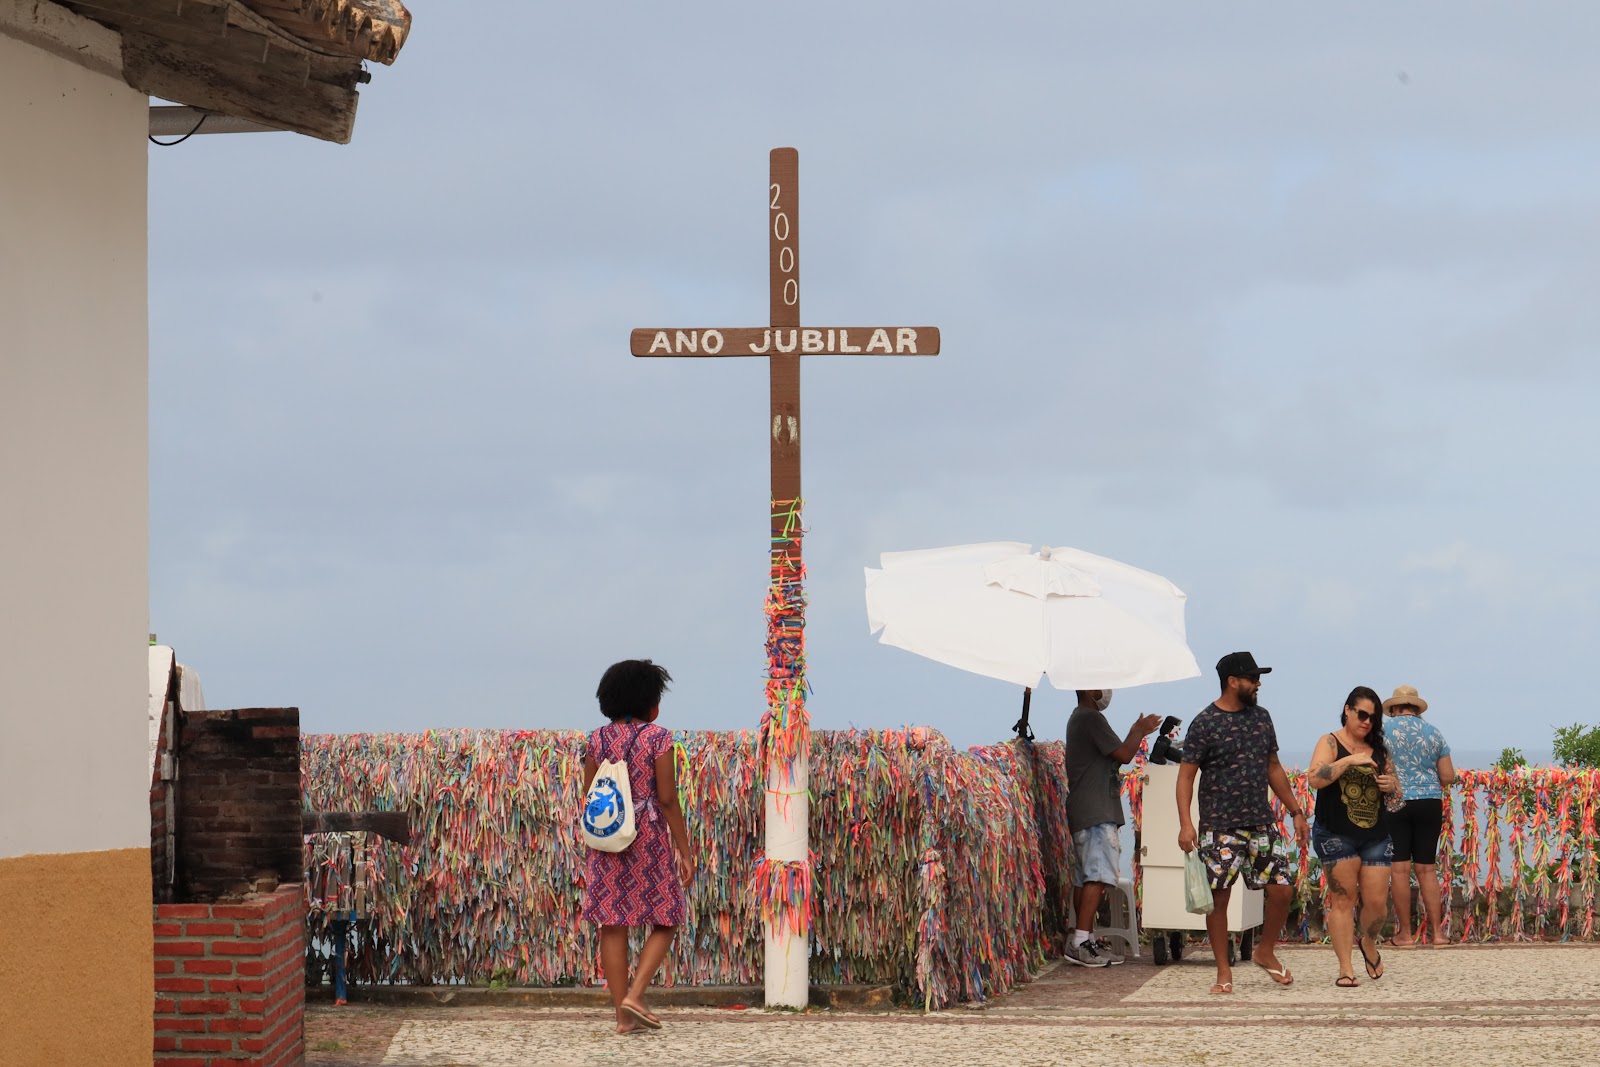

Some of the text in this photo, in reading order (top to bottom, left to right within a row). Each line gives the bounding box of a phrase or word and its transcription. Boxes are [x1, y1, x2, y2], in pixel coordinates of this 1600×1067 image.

[770, 183, 798, 306] 2000
[649, 327, 918, 354] ANO JUBILAR
